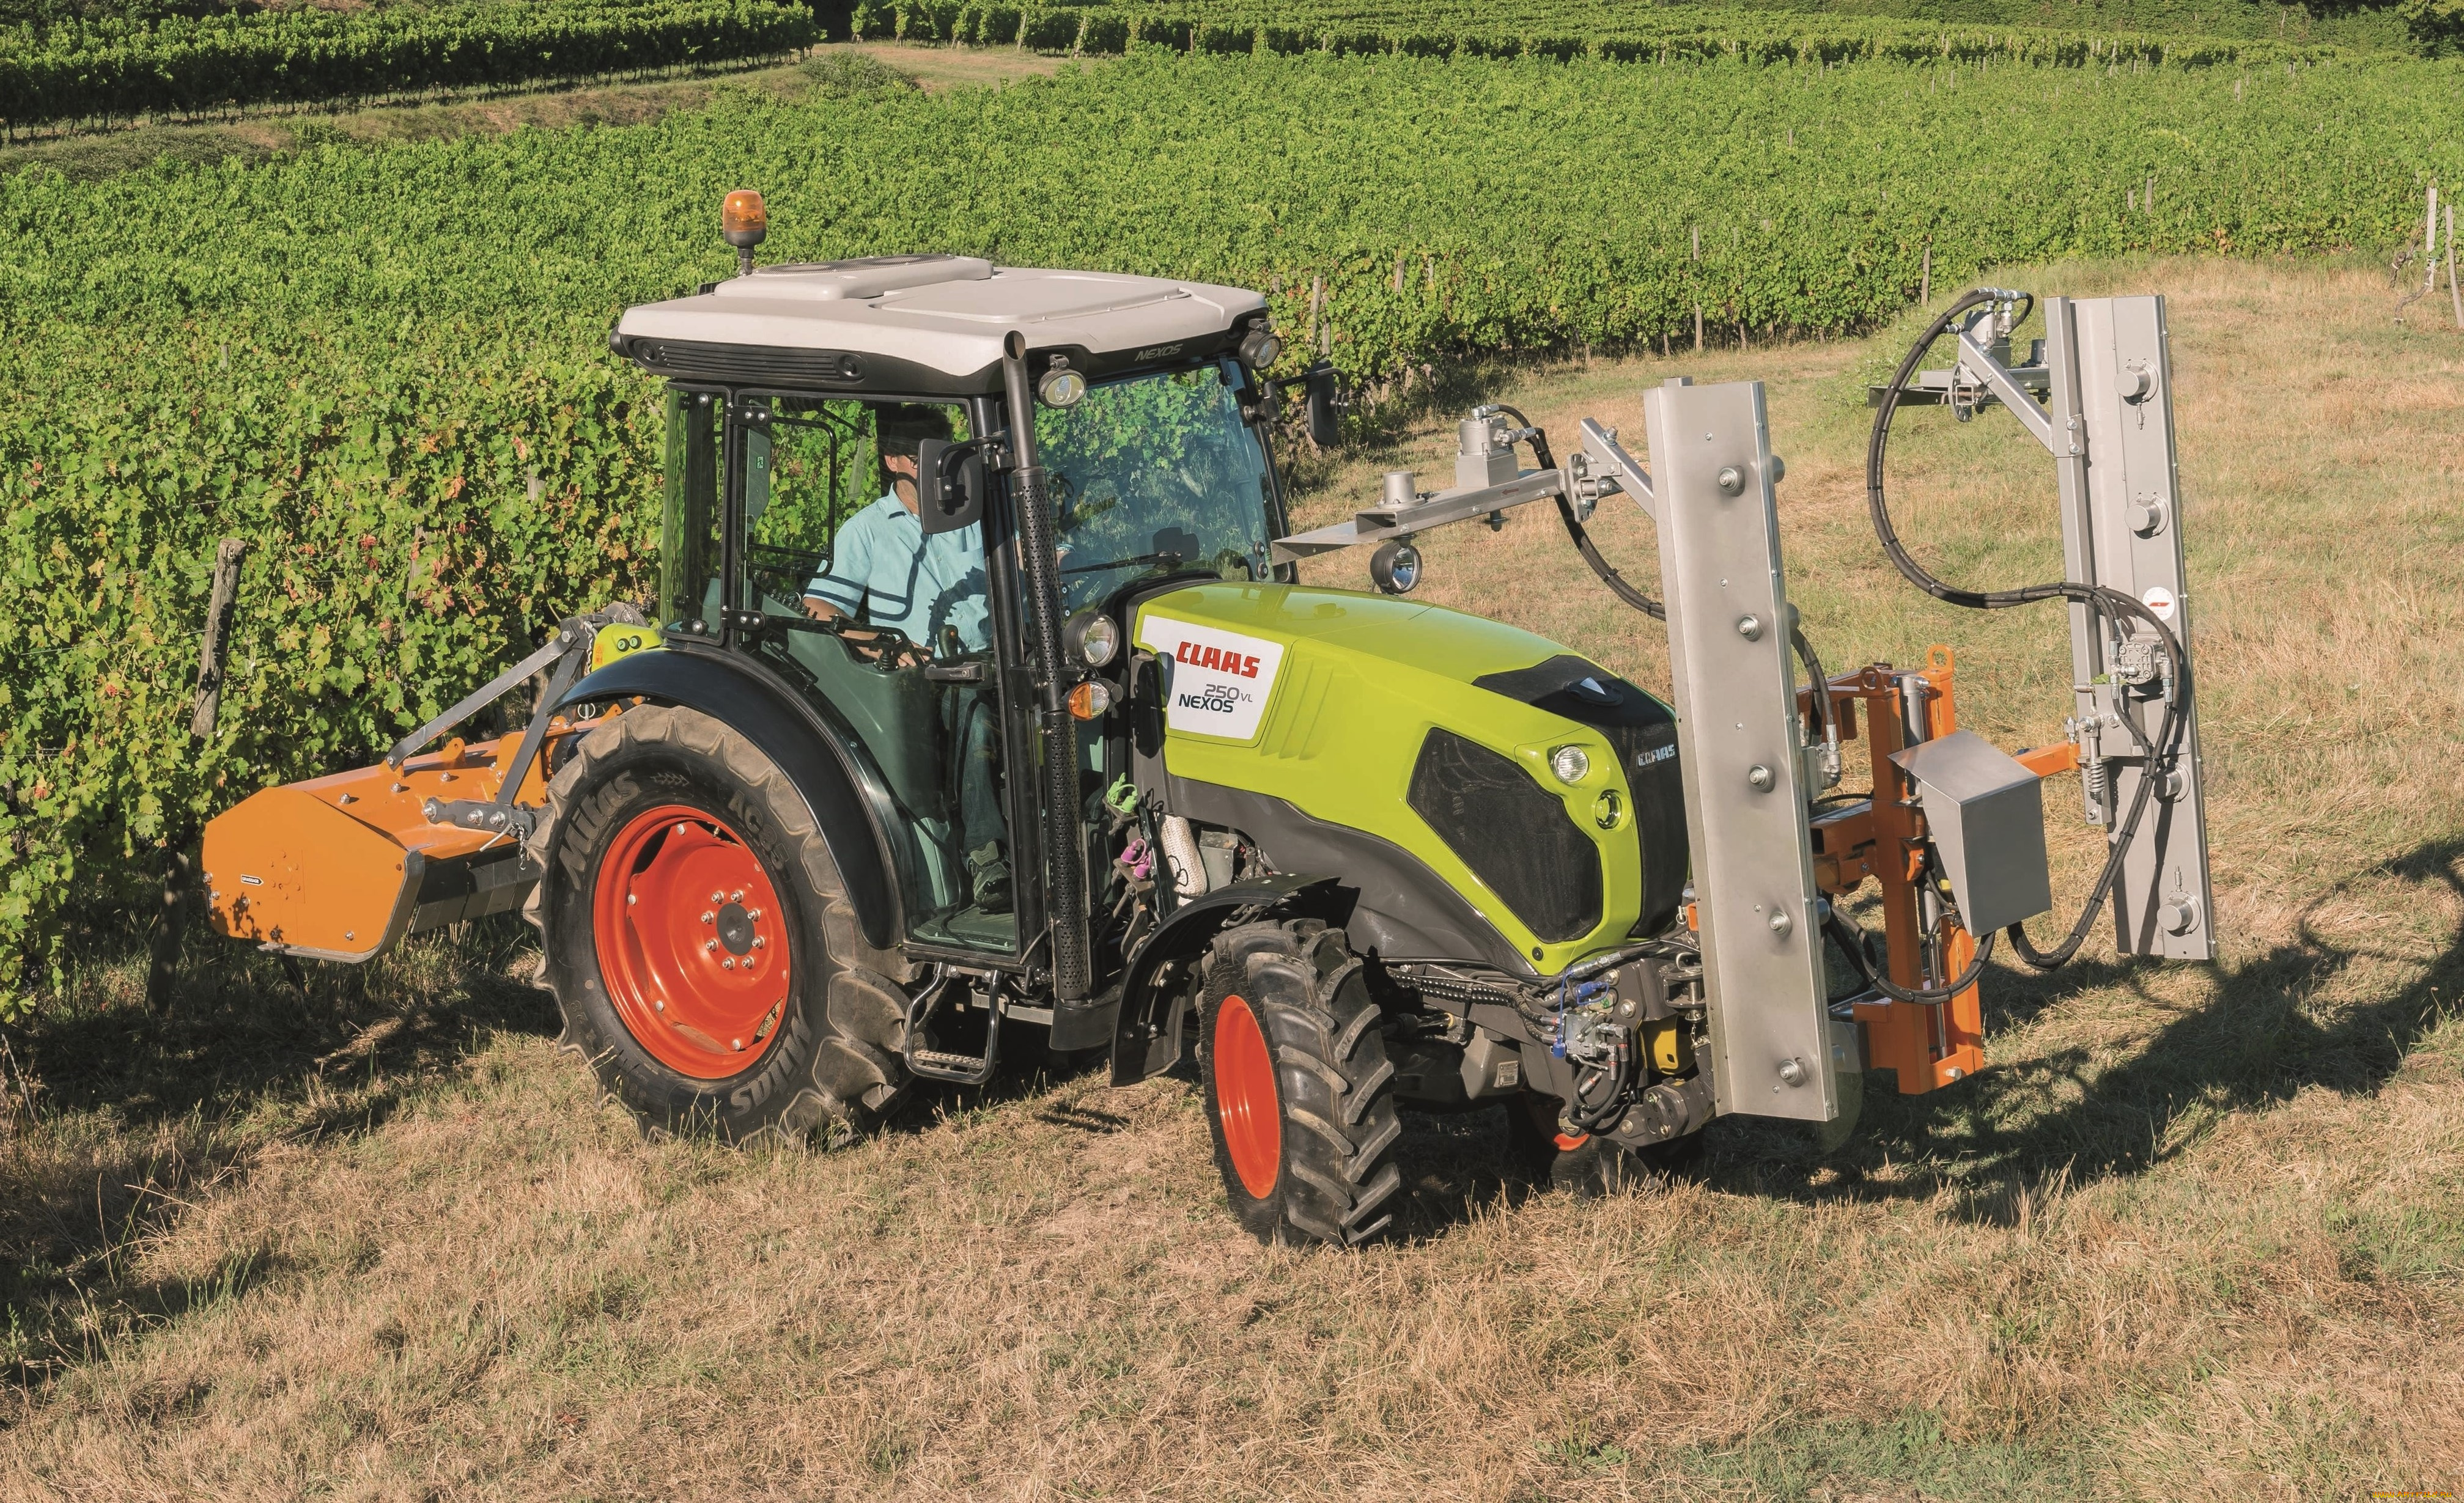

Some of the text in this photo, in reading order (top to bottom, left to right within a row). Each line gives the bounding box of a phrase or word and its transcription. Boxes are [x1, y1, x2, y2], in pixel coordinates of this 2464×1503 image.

[1135, 344, 1183, 361] NEXOS
[1176, 641, 1261, 678] CLAAS
[1204, 683, 1240, 700] 250
[1178, 694, 1234, 713] NEXOS
[1638, 744, 1675, 766] CLAAS
[559, 770, 640, 892] Mitas
[731, 996, 811, 1118] Mitas
